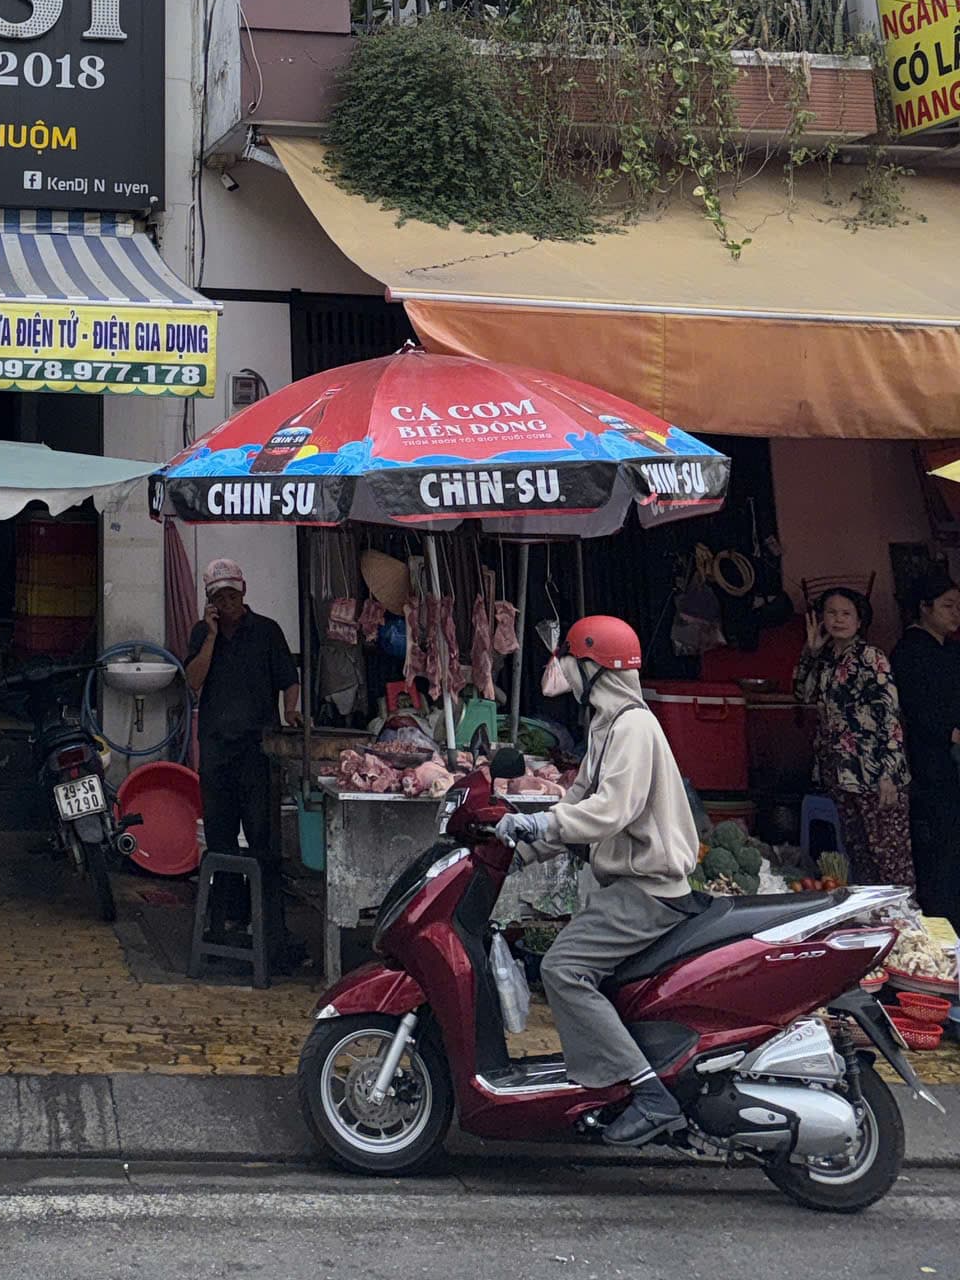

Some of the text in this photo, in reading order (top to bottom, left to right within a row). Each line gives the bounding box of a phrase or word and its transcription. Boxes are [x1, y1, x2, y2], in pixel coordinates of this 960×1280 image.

[893, 42, 929, 92] CÓ
[47, 177, 88, 194] KenDj
[16, 312, 53, 354] ĐIỆN
[58, 309, 79, 348] TỬ
[93, 315, 129, 356] ĐIỆN
[135, 322, 161, 352] GIA
[166, 324, 208, 359] DỤNG
[391, 399, 539, 421] CÁ CƠM
[207, 483, 316, 516] CHIN-SU
[420, 469, 564, 508] CHIN-SU
